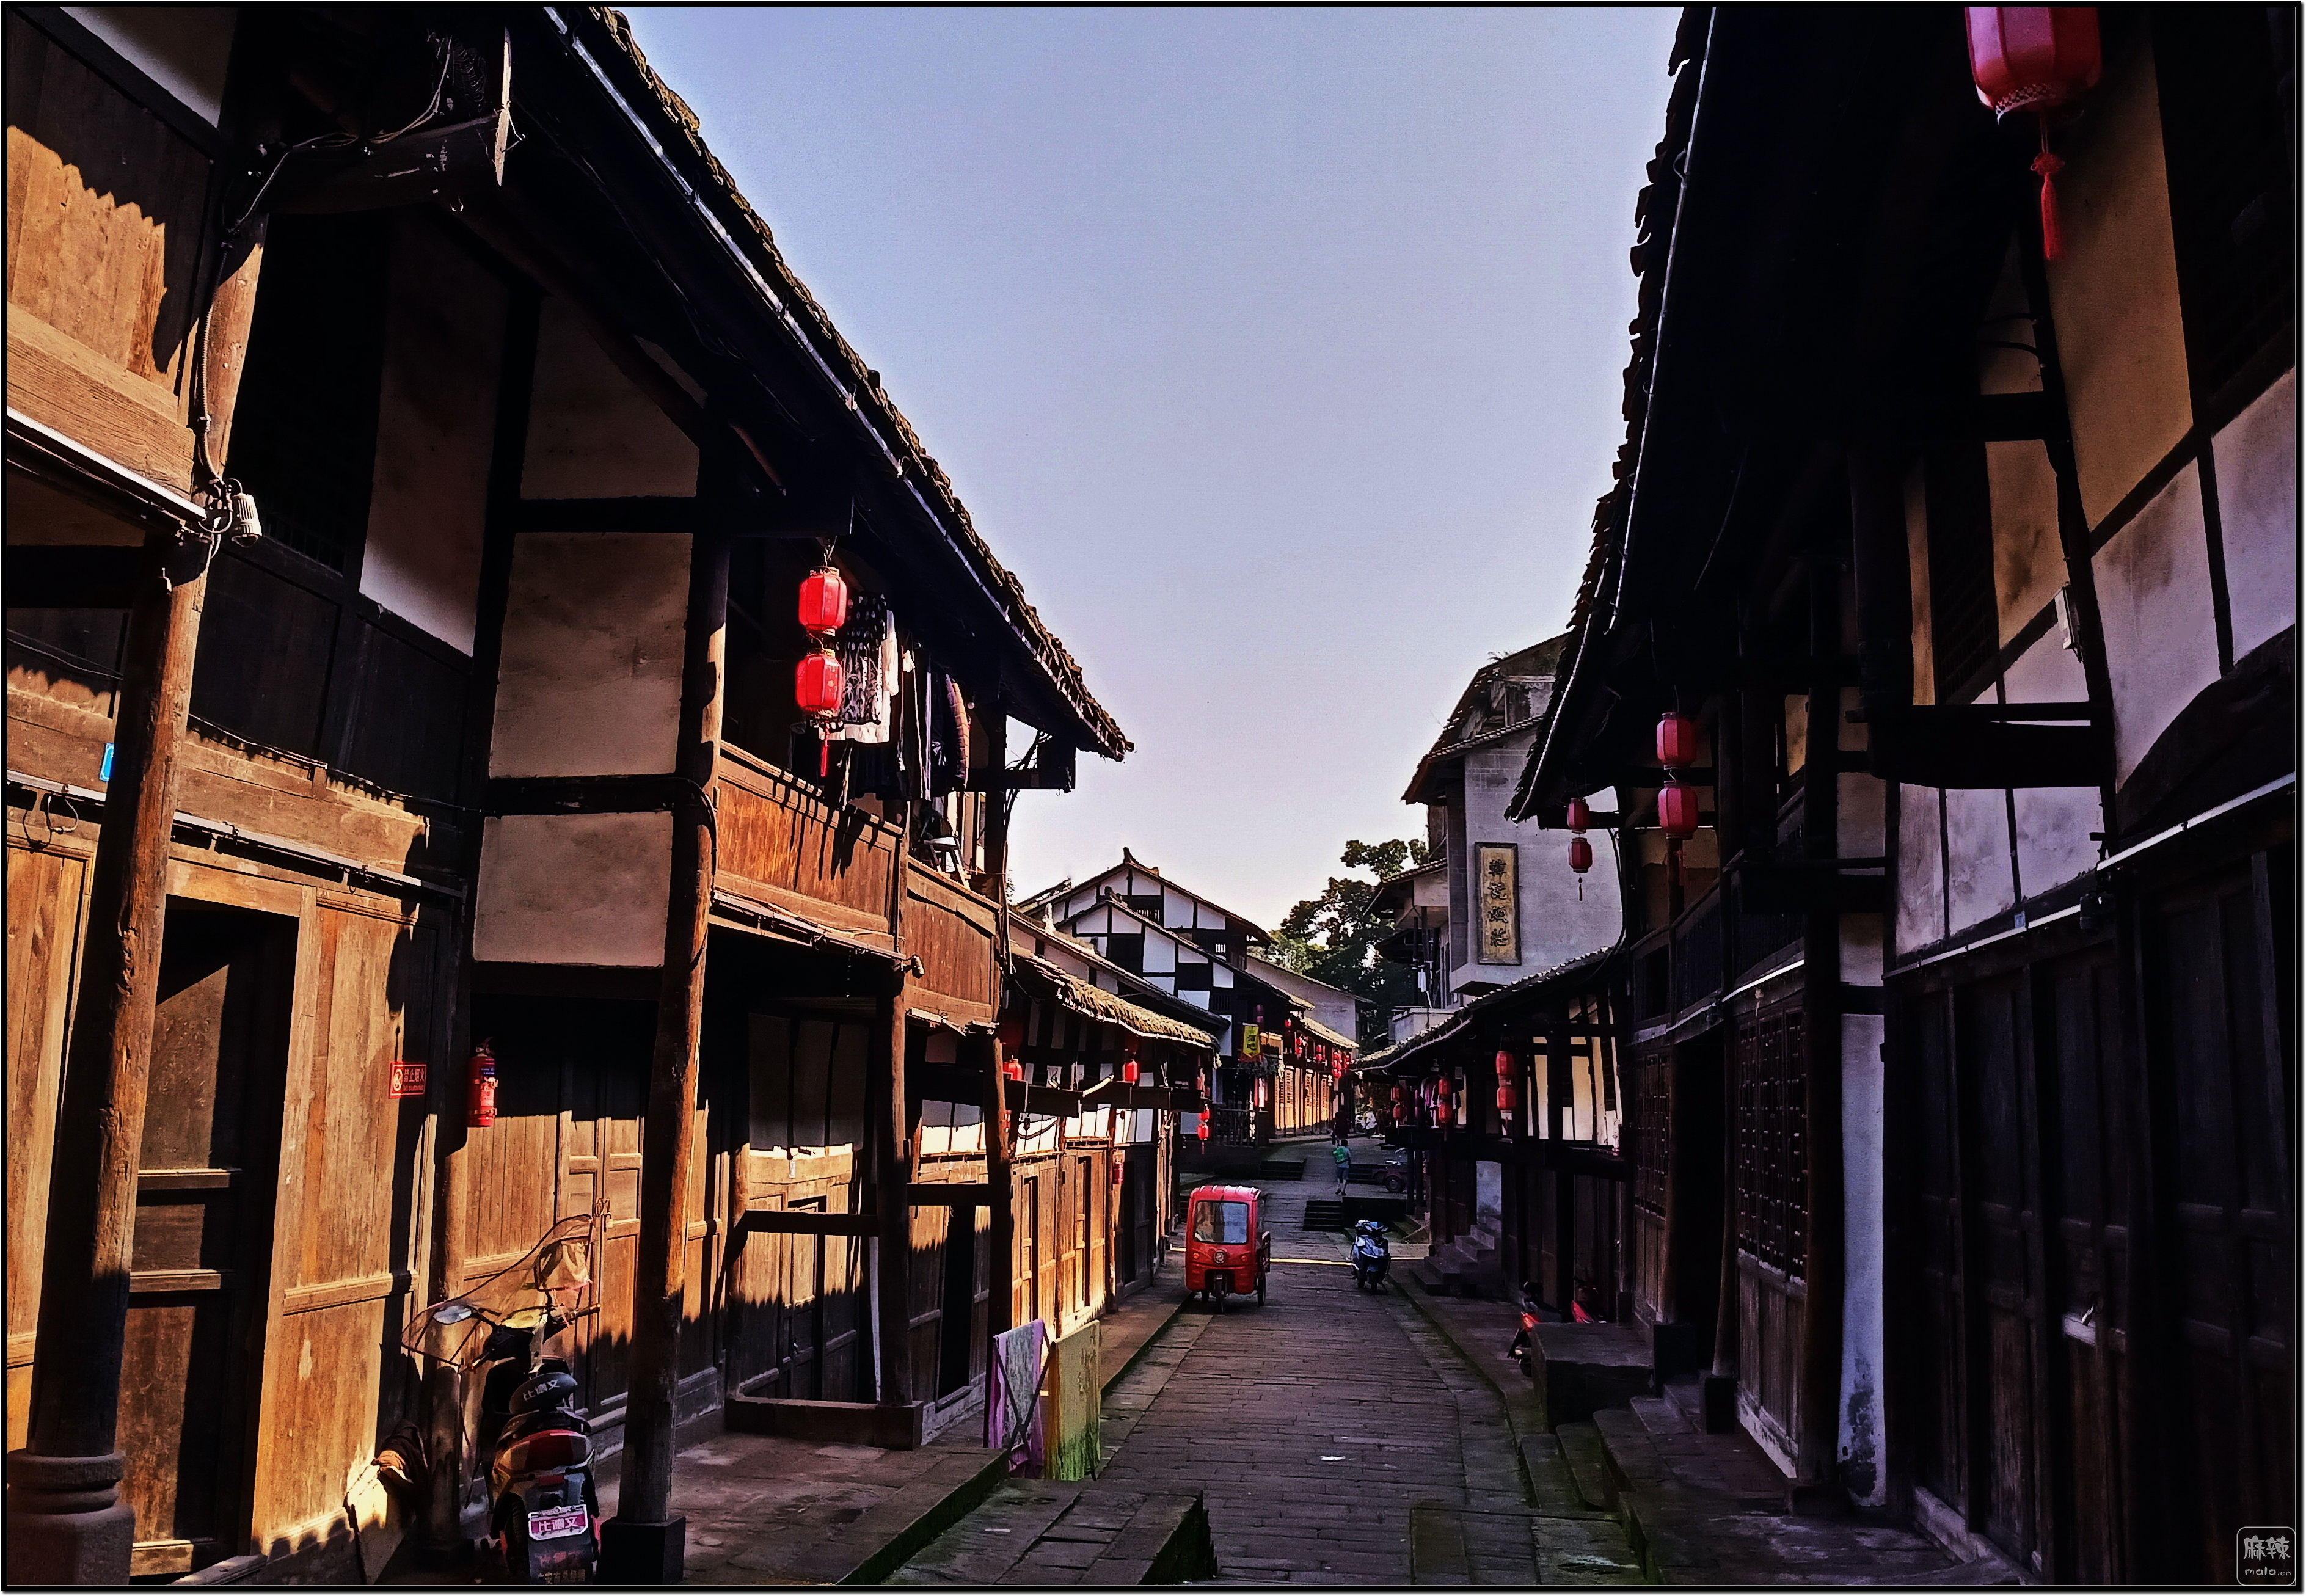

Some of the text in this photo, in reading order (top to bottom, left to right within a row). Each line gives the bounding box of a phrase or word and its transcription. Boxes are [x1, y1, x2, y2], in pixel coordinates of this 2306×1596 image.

[403, 1068, 425, 1083] 禁止烟火
[523, 1379, 561, 1401] 比德文
[538, 1516, 578, 1533] 比德文
